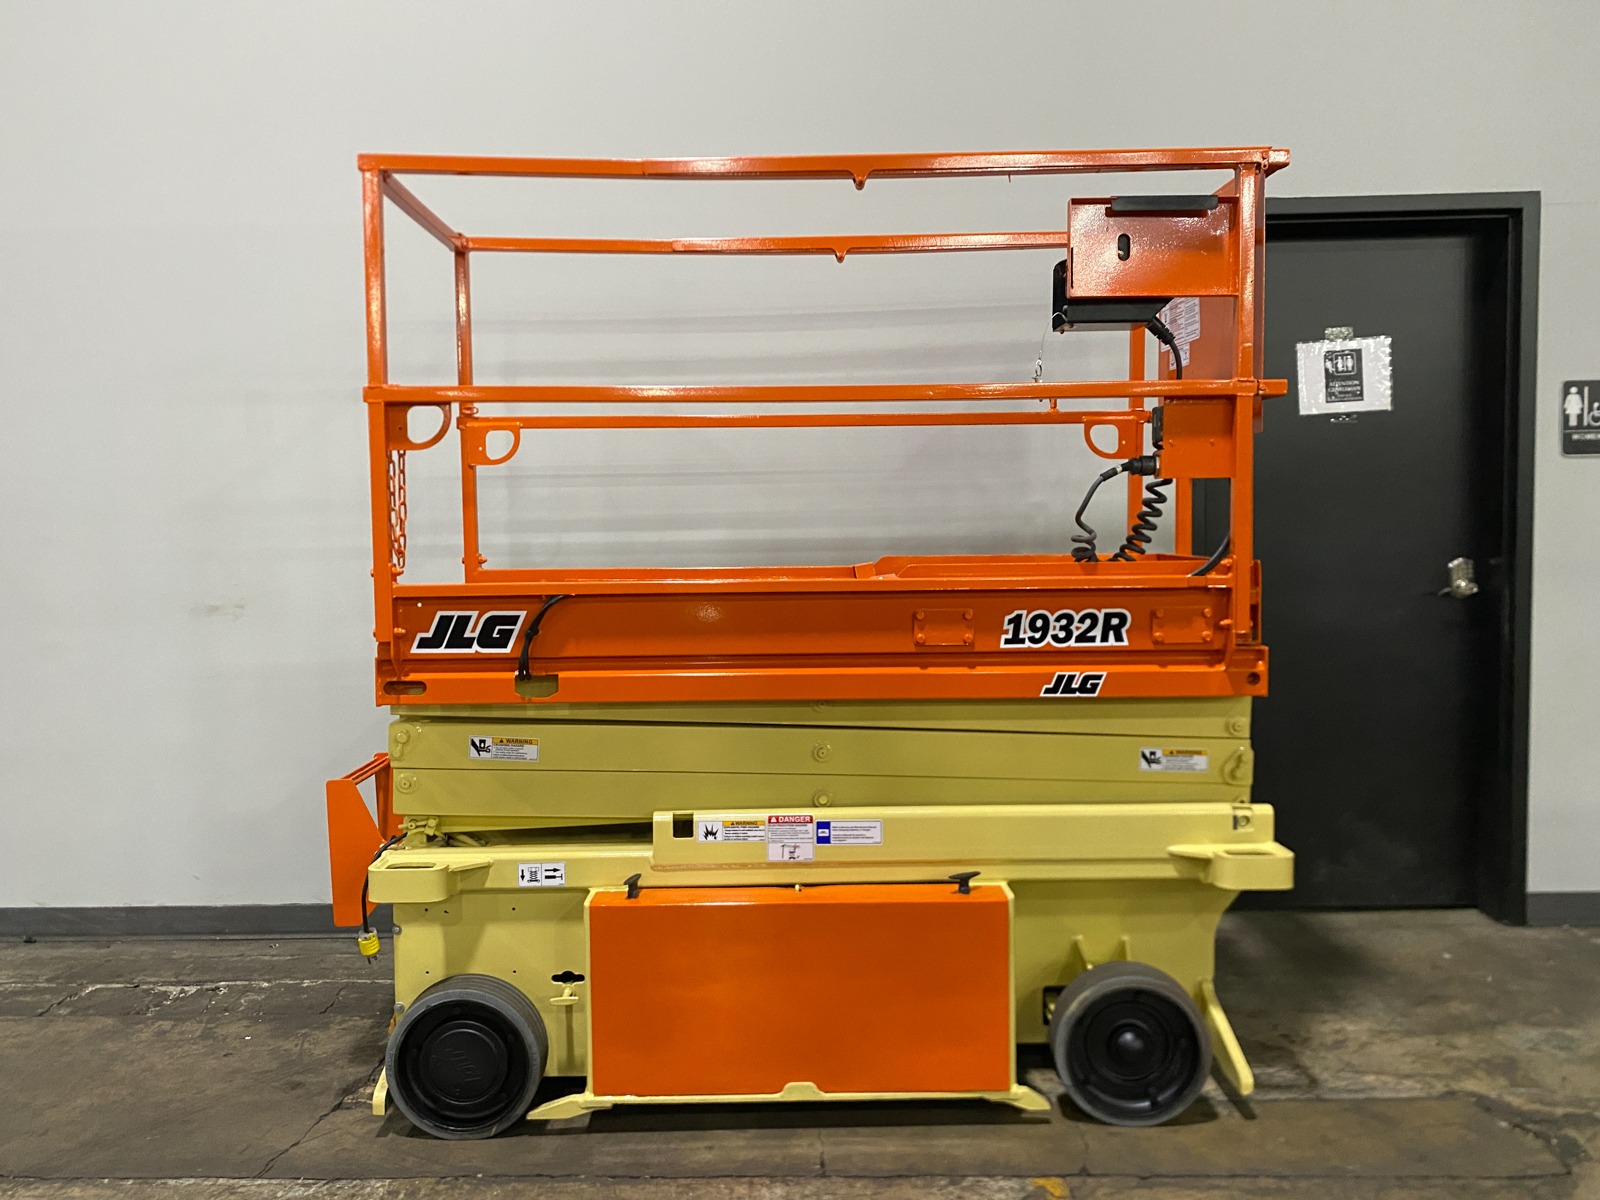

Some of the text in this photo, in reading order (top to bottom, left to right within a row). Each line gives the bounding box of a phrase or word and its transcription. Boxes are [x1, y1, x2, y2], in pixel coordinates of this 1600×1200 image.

[413, 613, 524, 651] JLG
[1002, 610, 1129, 647] 1932R
[1041, 673, 1106, 696] JLG
